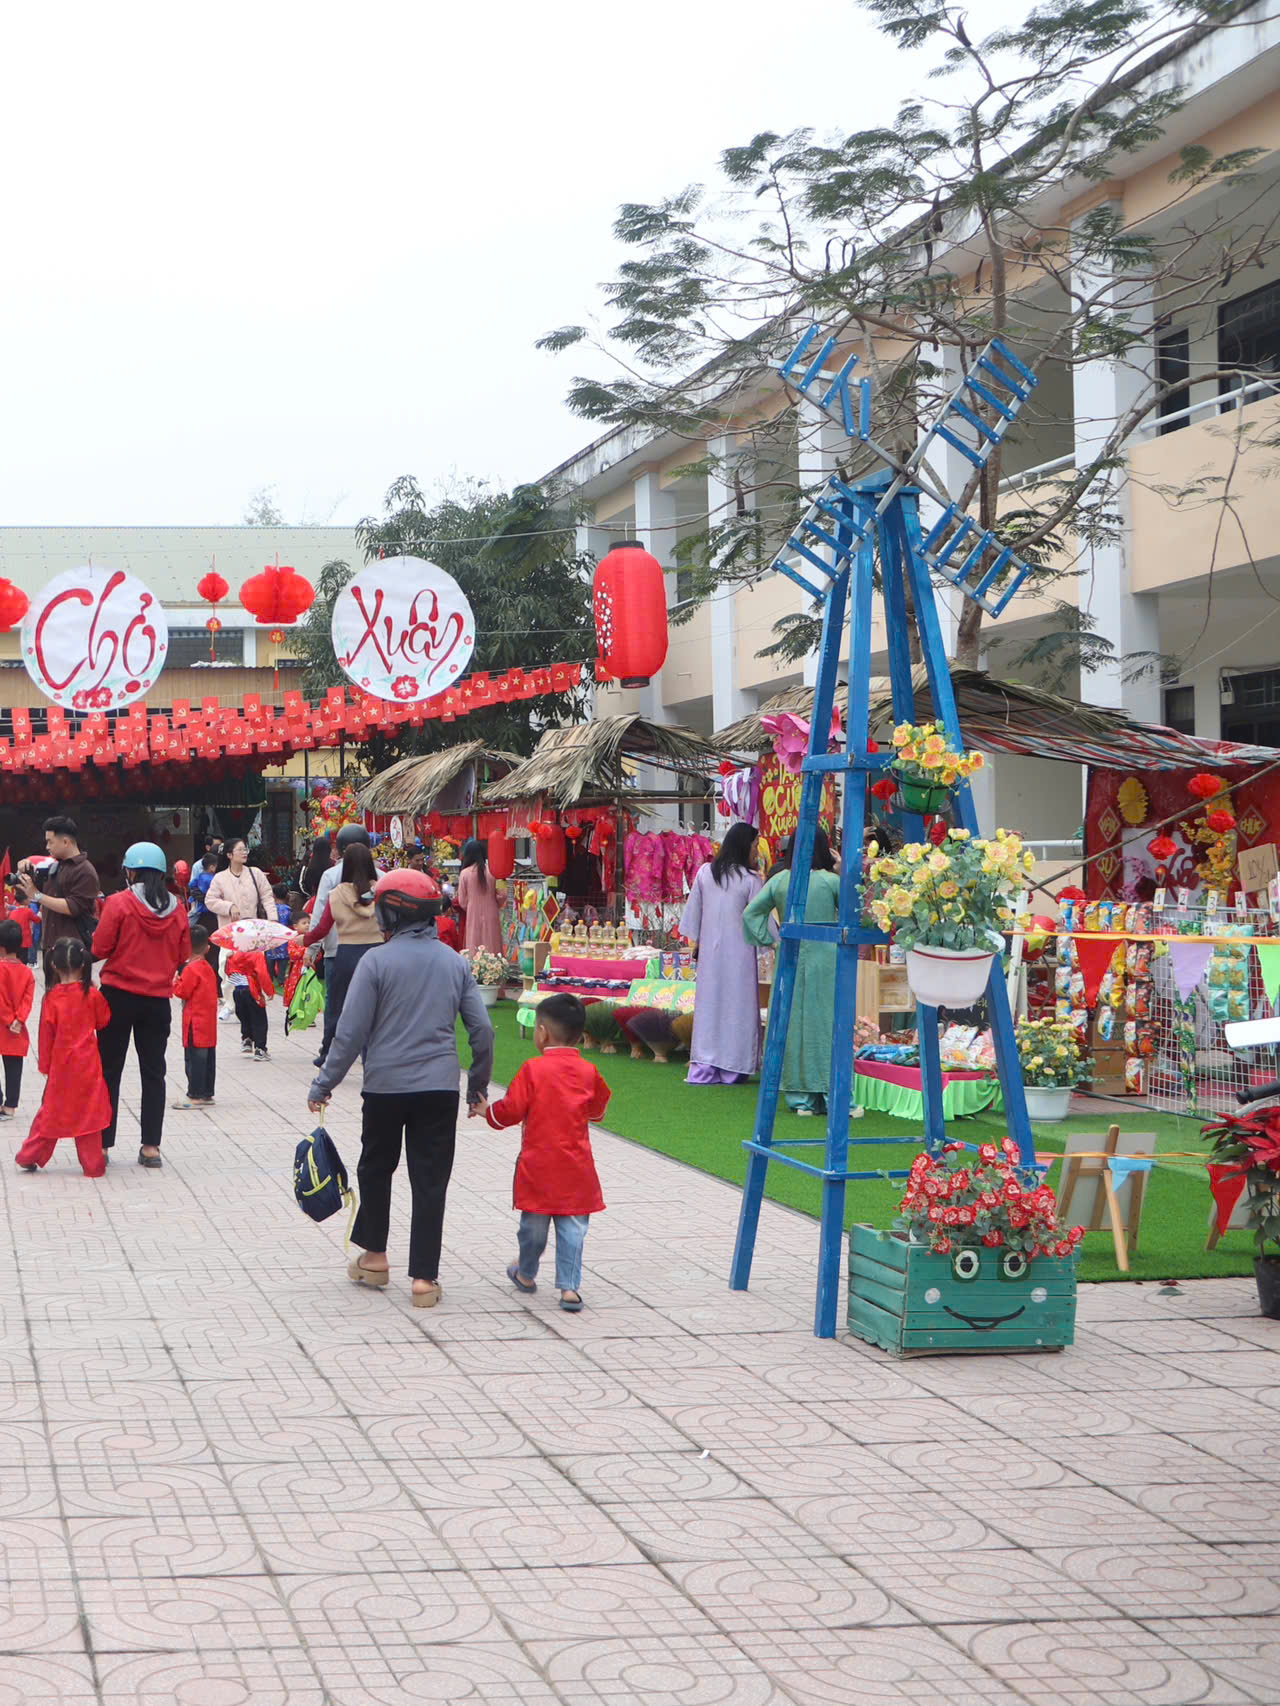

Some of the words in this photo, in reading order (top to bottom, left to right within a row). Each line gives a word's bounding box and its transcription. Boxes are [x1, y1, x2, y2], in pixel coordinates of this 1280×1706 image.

[35, 570, 157, 699] Chợ
[346, 585, 464, 687] Xuân
[1179, 893, 1187, 906] 2
[1208, 895, 1217, 909] 3
